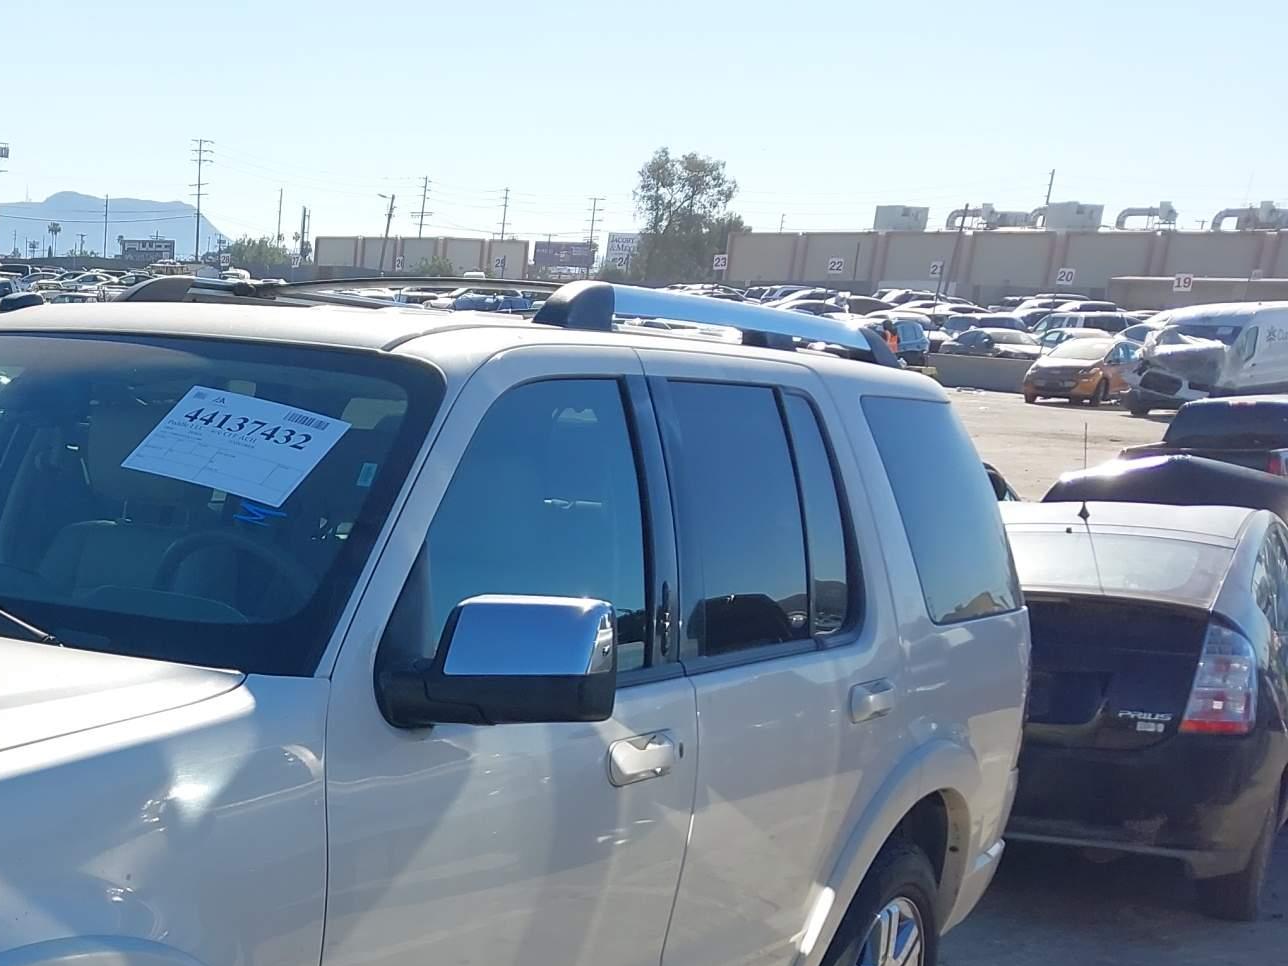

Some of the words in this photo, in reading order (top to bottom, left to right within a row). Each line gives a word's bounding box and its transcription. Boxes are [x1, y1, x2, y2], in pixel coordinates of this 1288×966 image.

[221, 255, 230, 263] 28
[714, 257, 727, 267] 23
[828, 261, 843, 271] 22
[1057, 271, 1073, 282] 20
[1174, 276, 1191, 289] 19
[184, 407, 312, 450] 44137432
[1118, 709, 1174, 721] PRIUS
